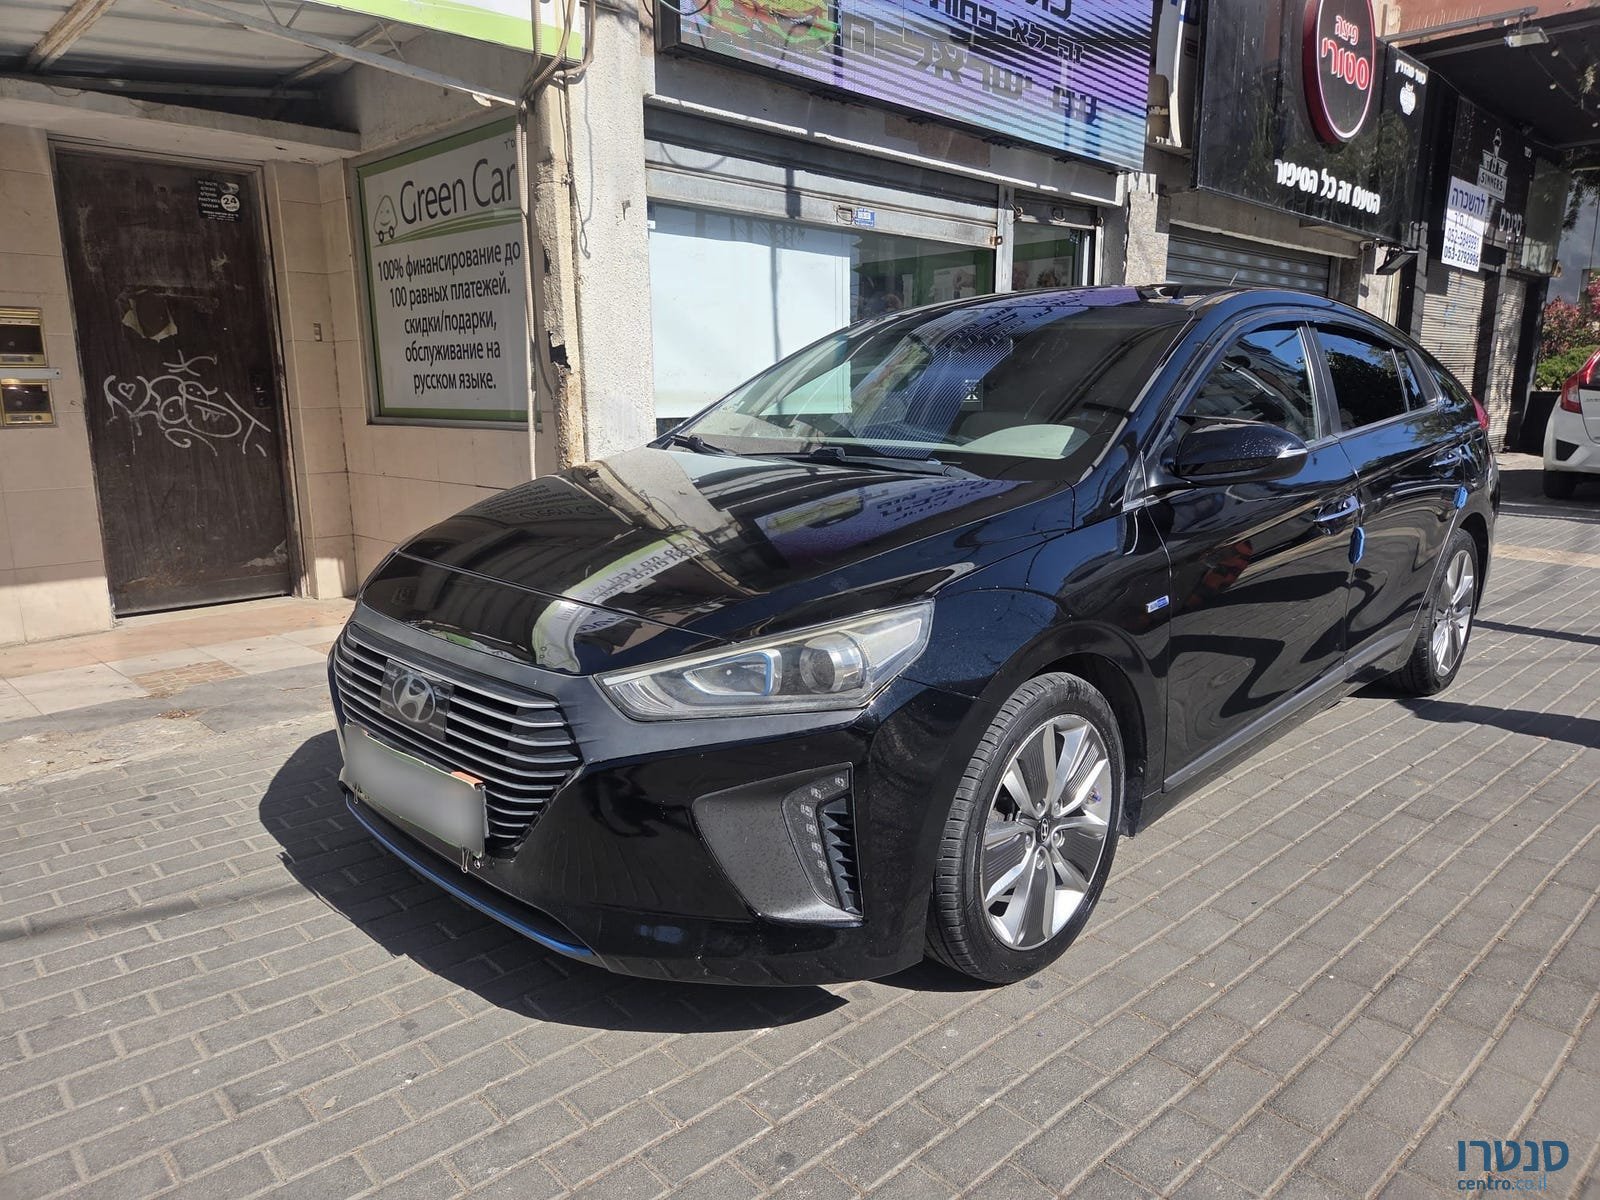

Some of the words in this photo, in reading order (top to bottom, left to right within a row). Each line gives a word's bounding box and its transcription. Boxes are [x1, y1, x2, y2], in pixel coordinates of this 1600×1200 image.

[1010, 18, 1047, 50] לא
[1335, 15, 1359, 45] פיצה
[1321, 37, 1370, 90] סטורי
[400, 178, 467, 225] Green
[473, 158, 516, 207] Car
[1274, 159, 1319, 194] הסיפור
[1320, 168, 1337, 199] כל
[1337, 180, 1352, 204] זה
[1352, 186, 1381, 215] הטעם
[1451, 188, 1485, 217] להשכרה
[378, 257, 404, 281] 100%
[405, 245, 502, 282] финансирование
[504, 240, 521, 267] до
[390, 286, 408, 308] 100
[409, 285, 449, 311] равных
[450, 271, 510, 301] платежей.
[404, 310, 497, 337] скидки/подарки,
[405, 341, 484, 367] обслуживание
[486, 340, 501, 359] на
[413, 372, 457, 394] русском
[458, 370, 497, 391] языке.
